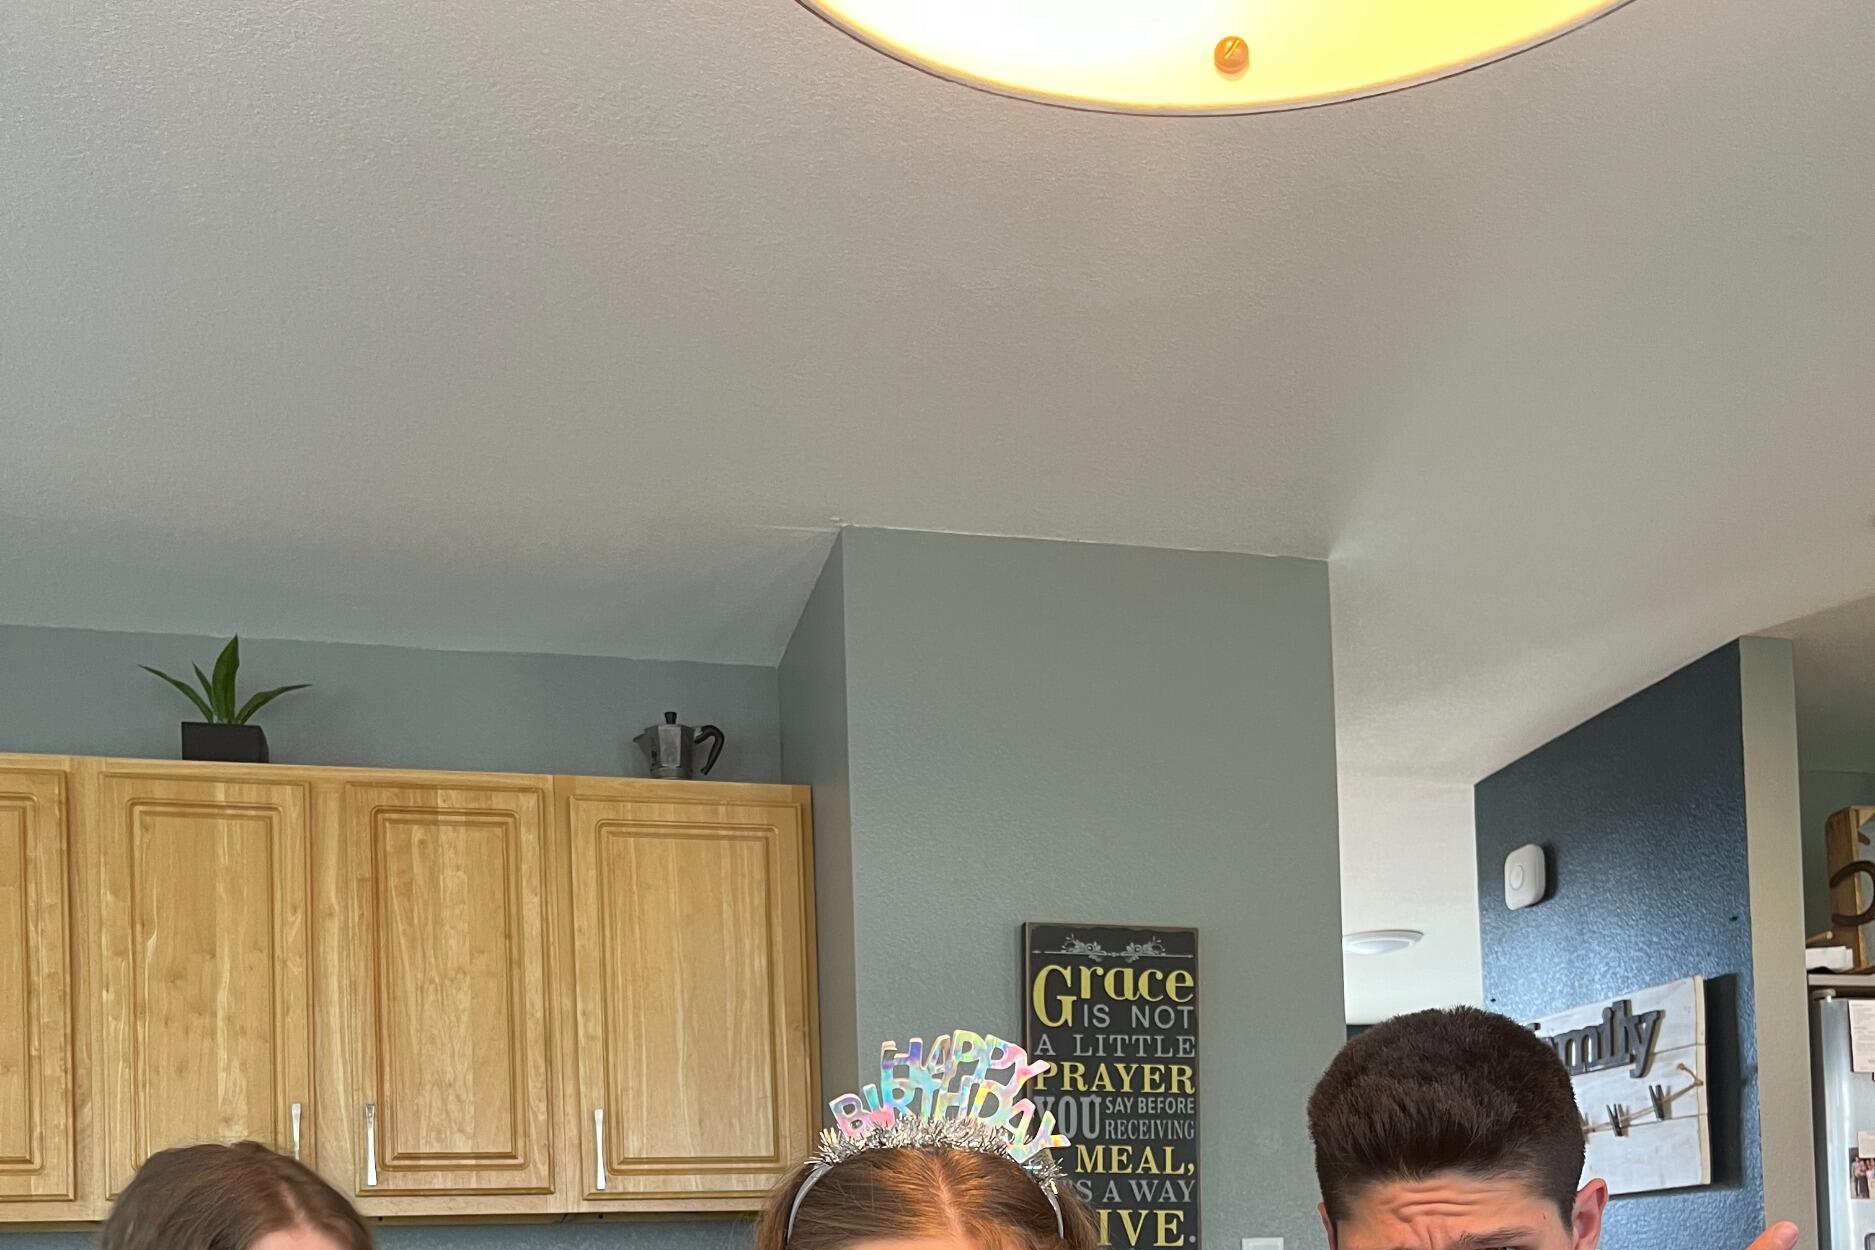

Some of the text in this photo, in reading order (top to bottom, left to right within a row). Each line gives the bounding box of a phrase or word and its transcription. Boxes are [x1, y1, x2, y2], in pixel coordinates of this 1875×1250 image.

[1033, 964, 1195, 1028] Grace
[1084, 1004, 1194, 1029] IS NOT
[1034, 1034, 1195, 1058] A LITTLE
[1526, 999, 1666, 1078] mily
[881, 1029, 1051, 1102] HAPPY
[1033, 1062, 1195, 1094] PRAYER
[828, 1075, 1072, 1163] BIRTHDAY
[1105, 1097, 1132, 1114] SAY
[1138, 1097, 1195, 1115] BEFORE
[1105, 1119, 1195, 1140] RECEIVING
[1075, 1145, 1195, 1175] MEAL,
[1102, 1180, 1122, 1202] A
[1130, 1181, 1195, 1202] WAY
[1097, 1210, 1196, 1247] IVE.
